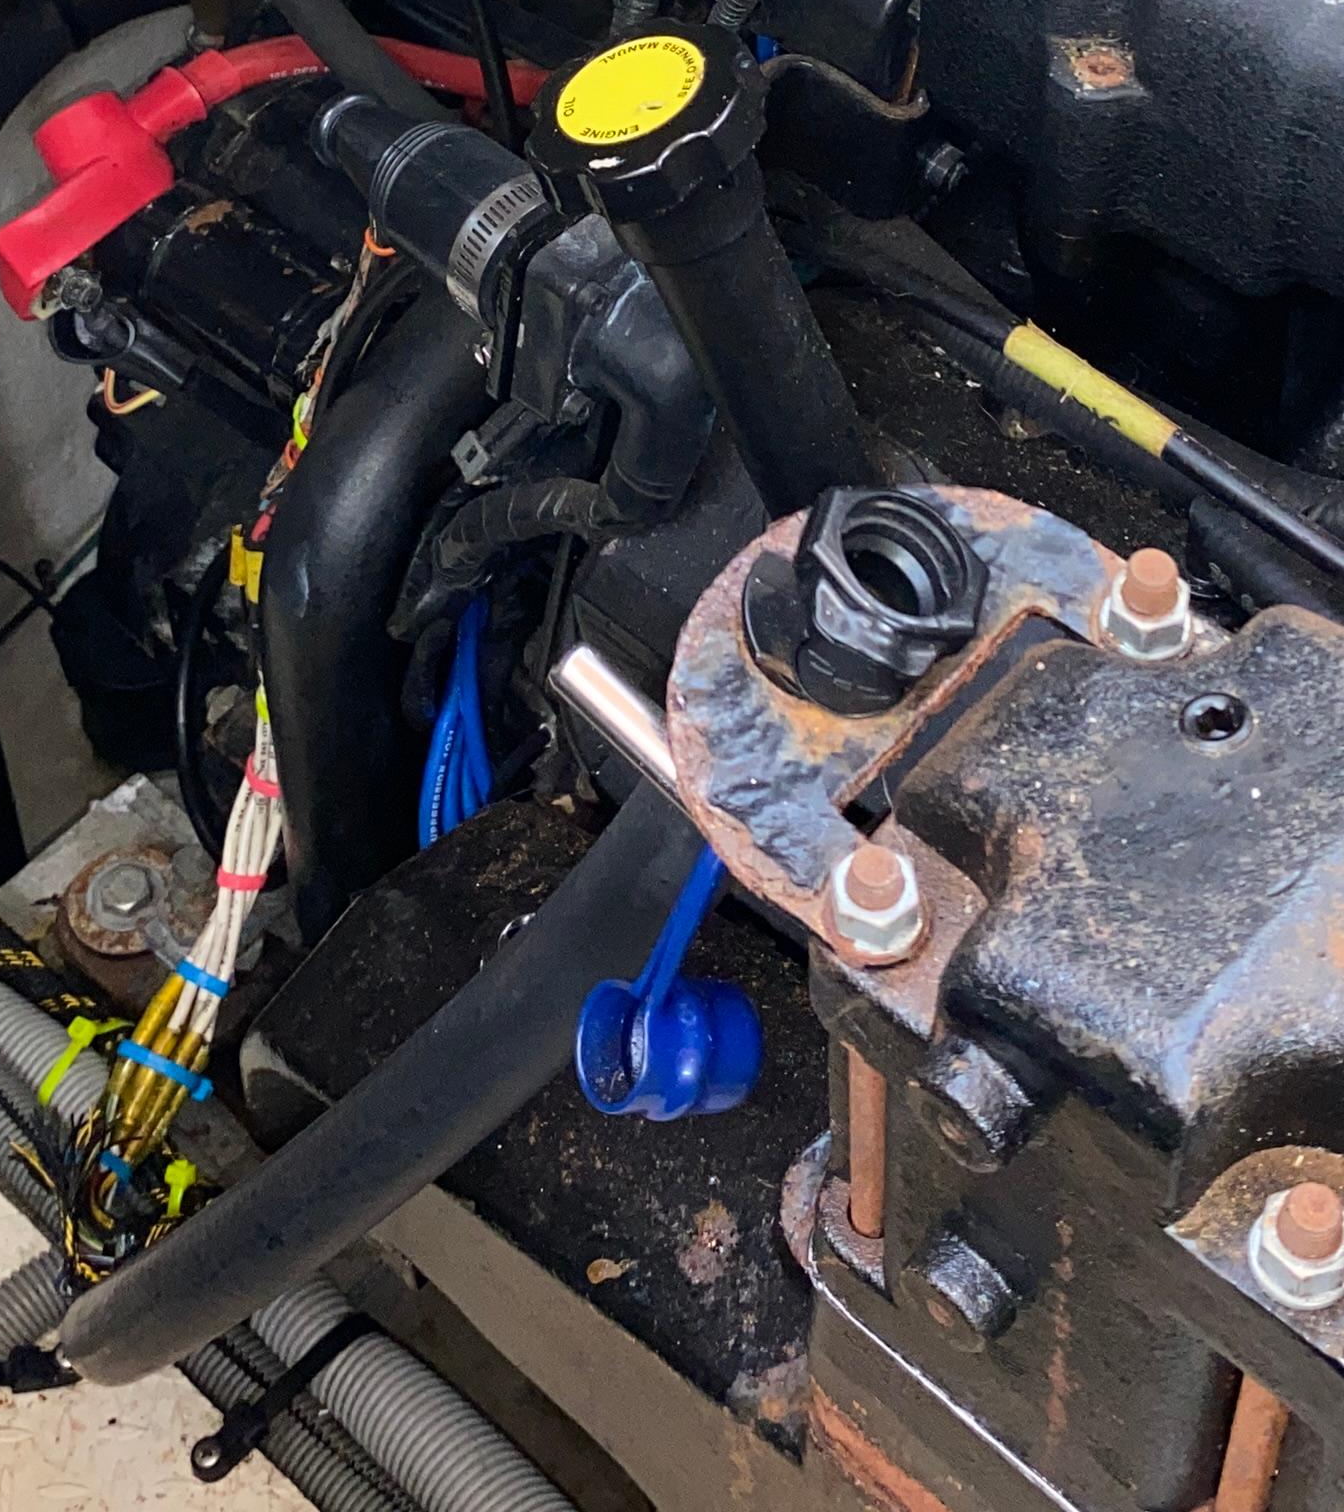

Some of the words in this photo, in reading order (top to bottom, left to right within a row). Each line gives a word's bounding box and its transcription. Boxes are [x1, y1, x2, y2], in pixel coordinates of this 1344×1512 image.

[598, 41, 660, 65] MANUAL
[662, 42, 697, 74] OWNERS
[677, 76, 696, 99] SEE
[563, 96, 576, 117] OIL
[579, 124, 640, 140] ENGINE
